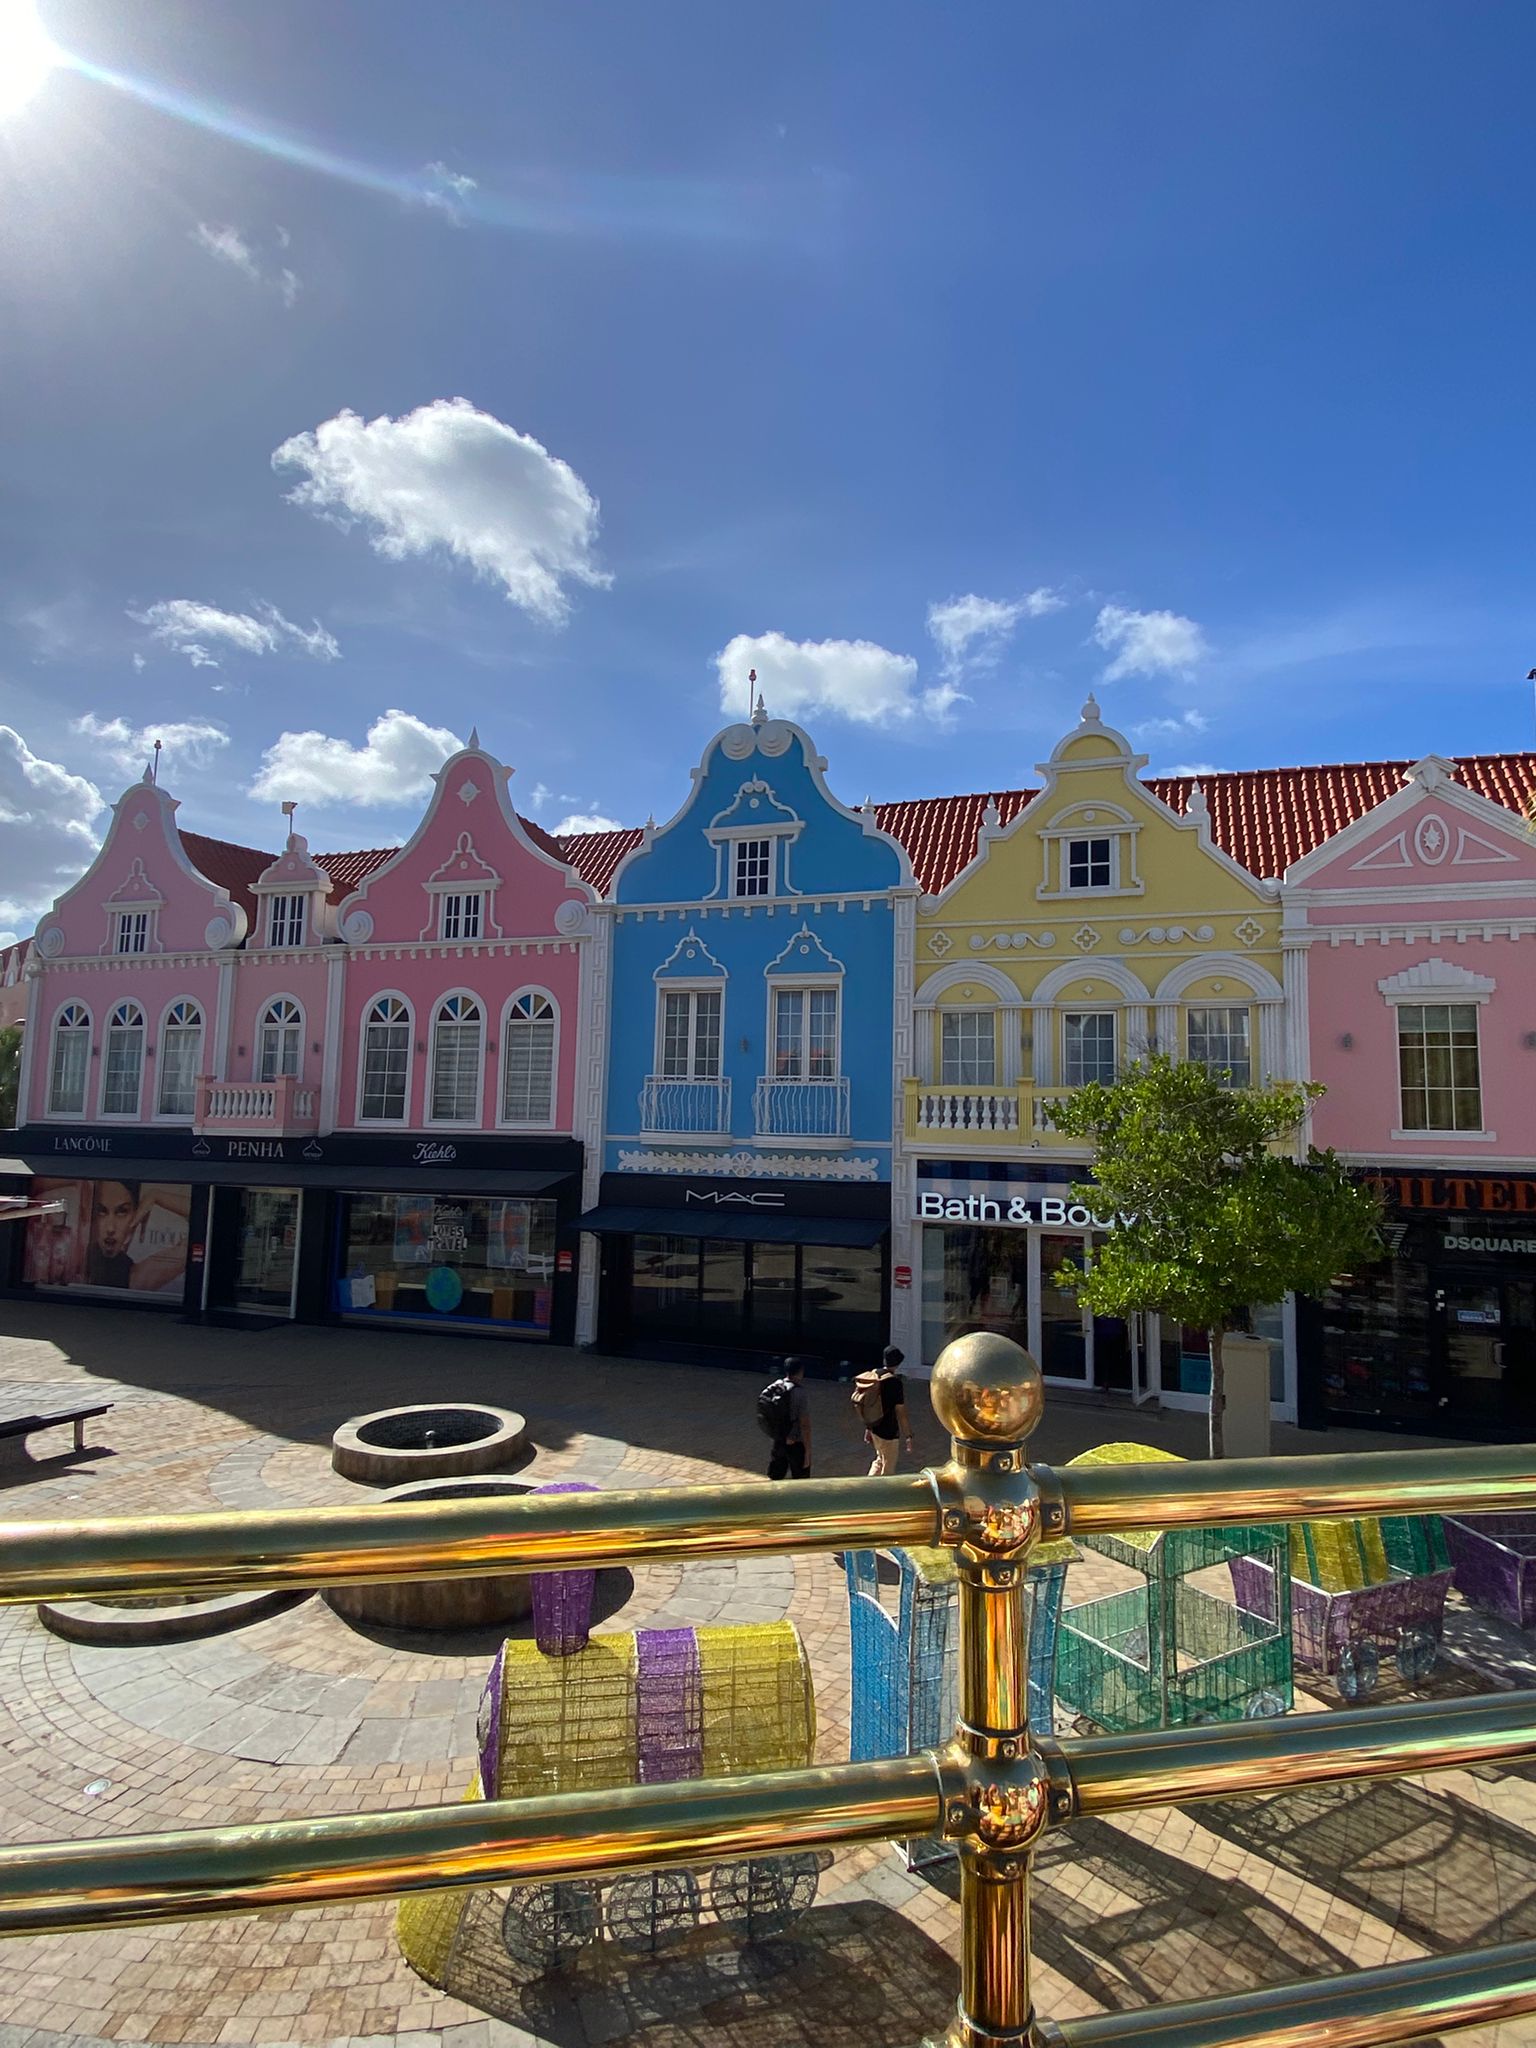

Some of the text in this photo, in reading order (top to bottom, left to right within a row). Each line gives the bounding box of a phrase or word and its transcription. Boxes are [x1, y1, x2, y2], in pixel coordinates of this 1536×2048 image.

[54, 1136, 112, 1152] LANCÔME
[228, 1141, 284, 1158] PENHA
[412, 1142, 457, 1164] Kiehl's
[921, 1192, 1000, 1222] Bath
[1007, 1196, 1034, 1224] &
